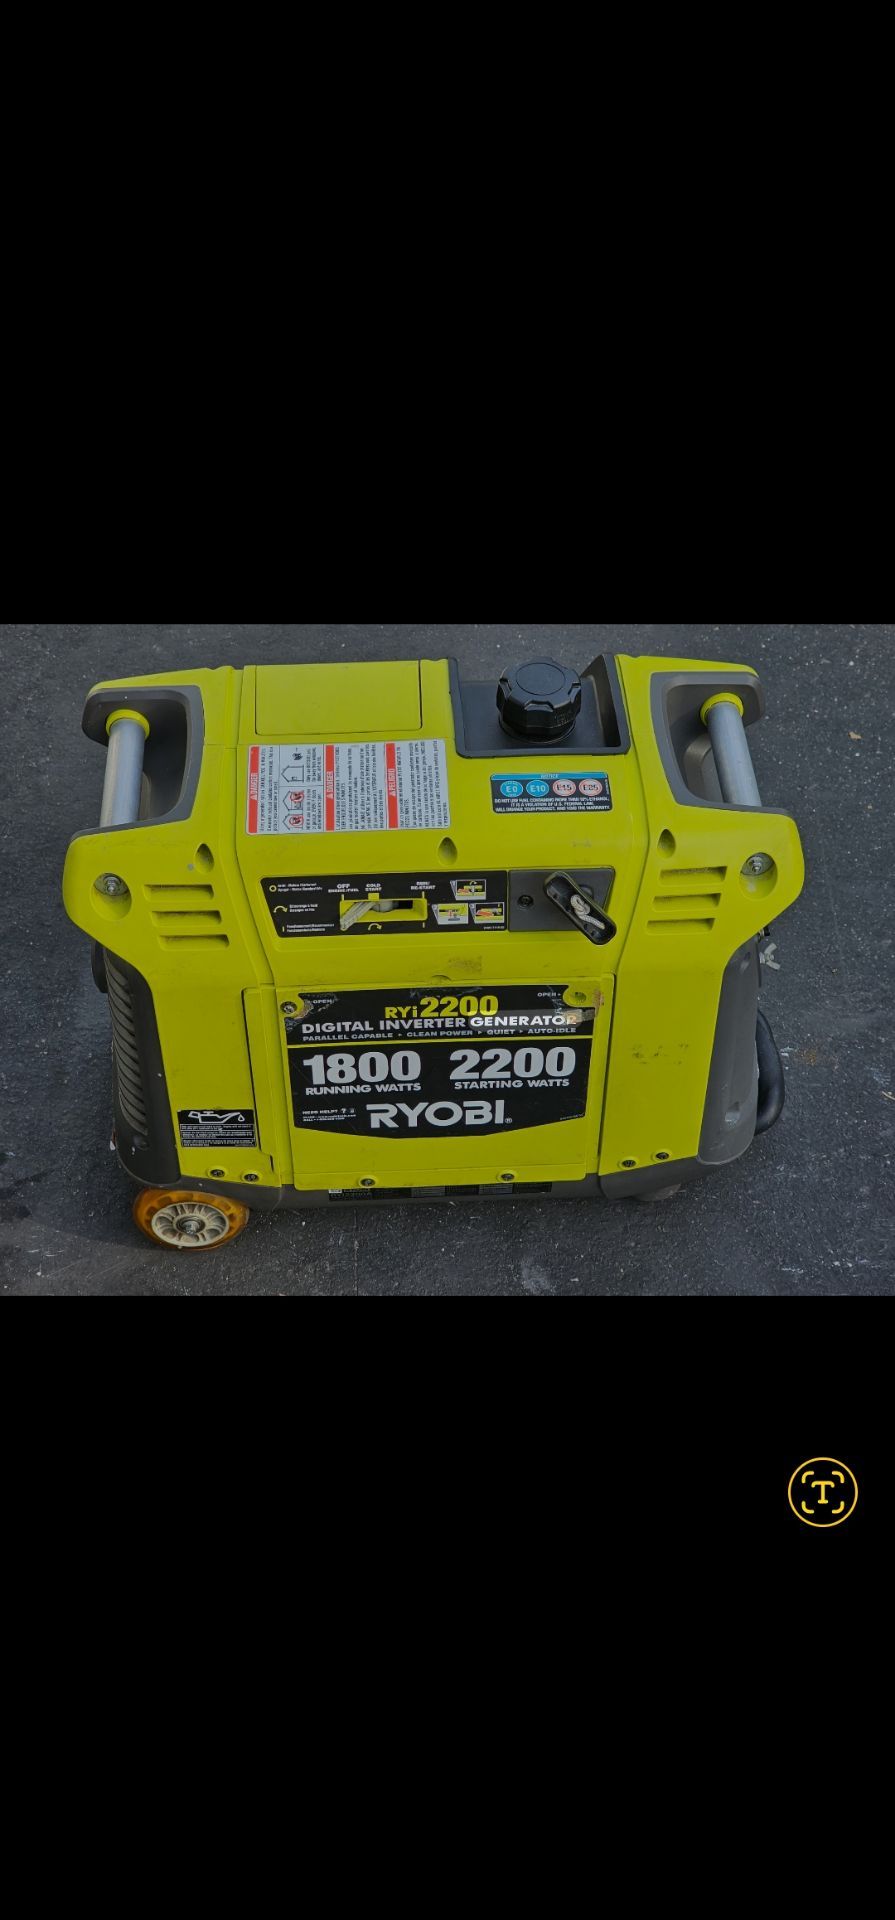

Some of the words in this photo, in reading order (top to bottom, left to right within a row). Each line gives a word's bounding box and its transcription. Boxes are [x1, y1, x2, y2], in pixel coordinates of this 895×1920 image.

[529, 784, 546, 792] E10
[301, 1021, 374, 1034] DIGITAL
[379, 1017, 466, 1030] INVERTER
[303, 1050, 421, 1085] 1800
[449, 1046, 576, 1080] 2200
[305, 1084, 372, 1096] RUNNING
[375, 1082, 422, 1093] WATTS
[454, 1079, 524, 1090] STARTING
[526, 1078, 570, 1088] WATTS
[366, 1100, 505, 1129] RYOBI
